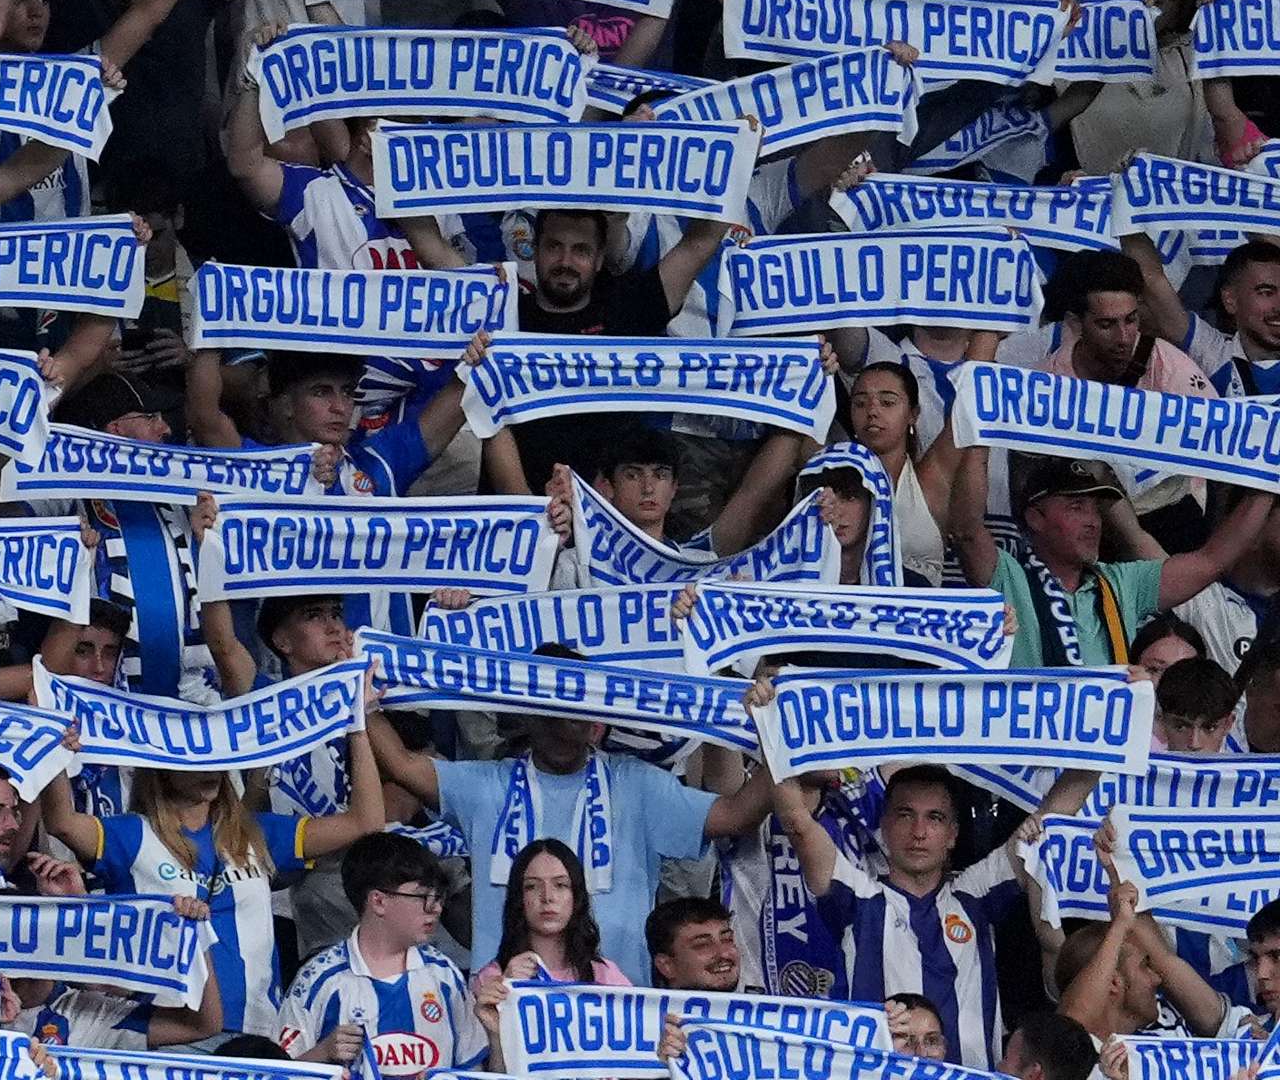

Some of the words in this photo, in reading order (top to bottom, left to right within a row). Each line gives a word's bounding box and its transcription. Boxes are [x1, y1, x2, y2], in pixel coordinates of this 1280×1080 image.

[921, 1, 1047, 66] PERICO
[261, 36, 434, 109] ORGULLO
[449, 34, 579, 108] PERICO
[388, 135, 571, 193] ORGULLO
[588, 135, 734, 198] PERICO
[199, 269, 367, 324] ORGULLO
[380, 274, 508, 333] PERICO
[900, 242, 1033, 304] PERICO
[471, 352, 662, 408] ORGULLO
[678, 354, 824, 411] PERICO
[974, 365, 1144, 440] ORGULLO
[222, 518, 387, 574] ORGULLO
[401, 517, 536, 575] PERICO
[689, 597, 861, 649] ORGULLO
[362, 644, 586, 702] ORGULLO
[780, 682, 967, 748] ORGULLO
[981, 684, 1131, 746] PERICO
[55, 901, 198, 975] PERICO
